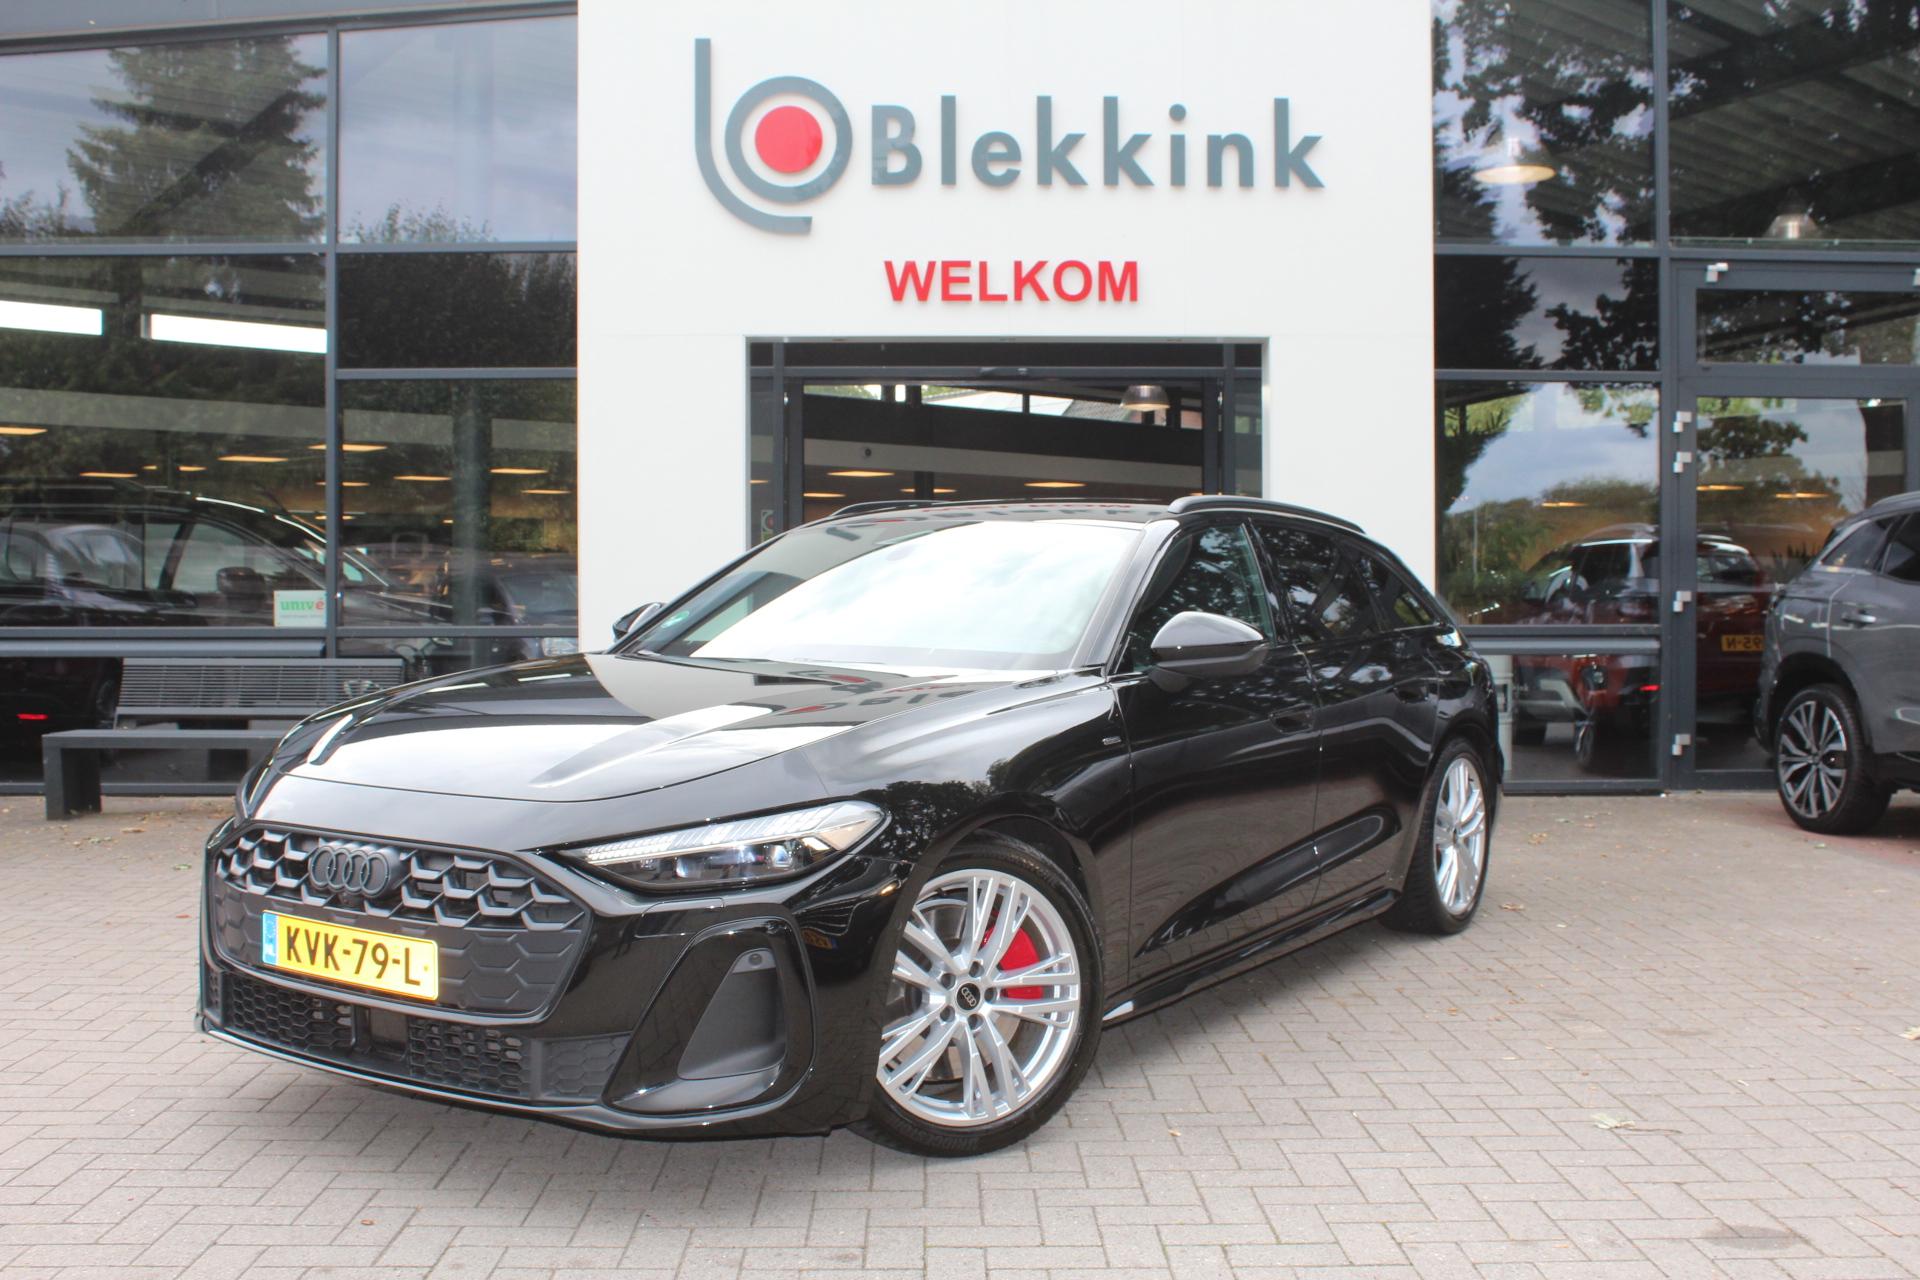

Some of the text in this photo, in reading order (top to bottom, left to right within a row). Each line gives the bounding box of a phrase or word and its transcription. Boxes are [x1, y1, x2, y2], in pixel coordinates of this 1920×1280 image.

[872, 95, 1324, 188] Blekkink
[884, 260, 1139, 302] WELKOM
[286, 926, 421, 986] KVK-79-L
